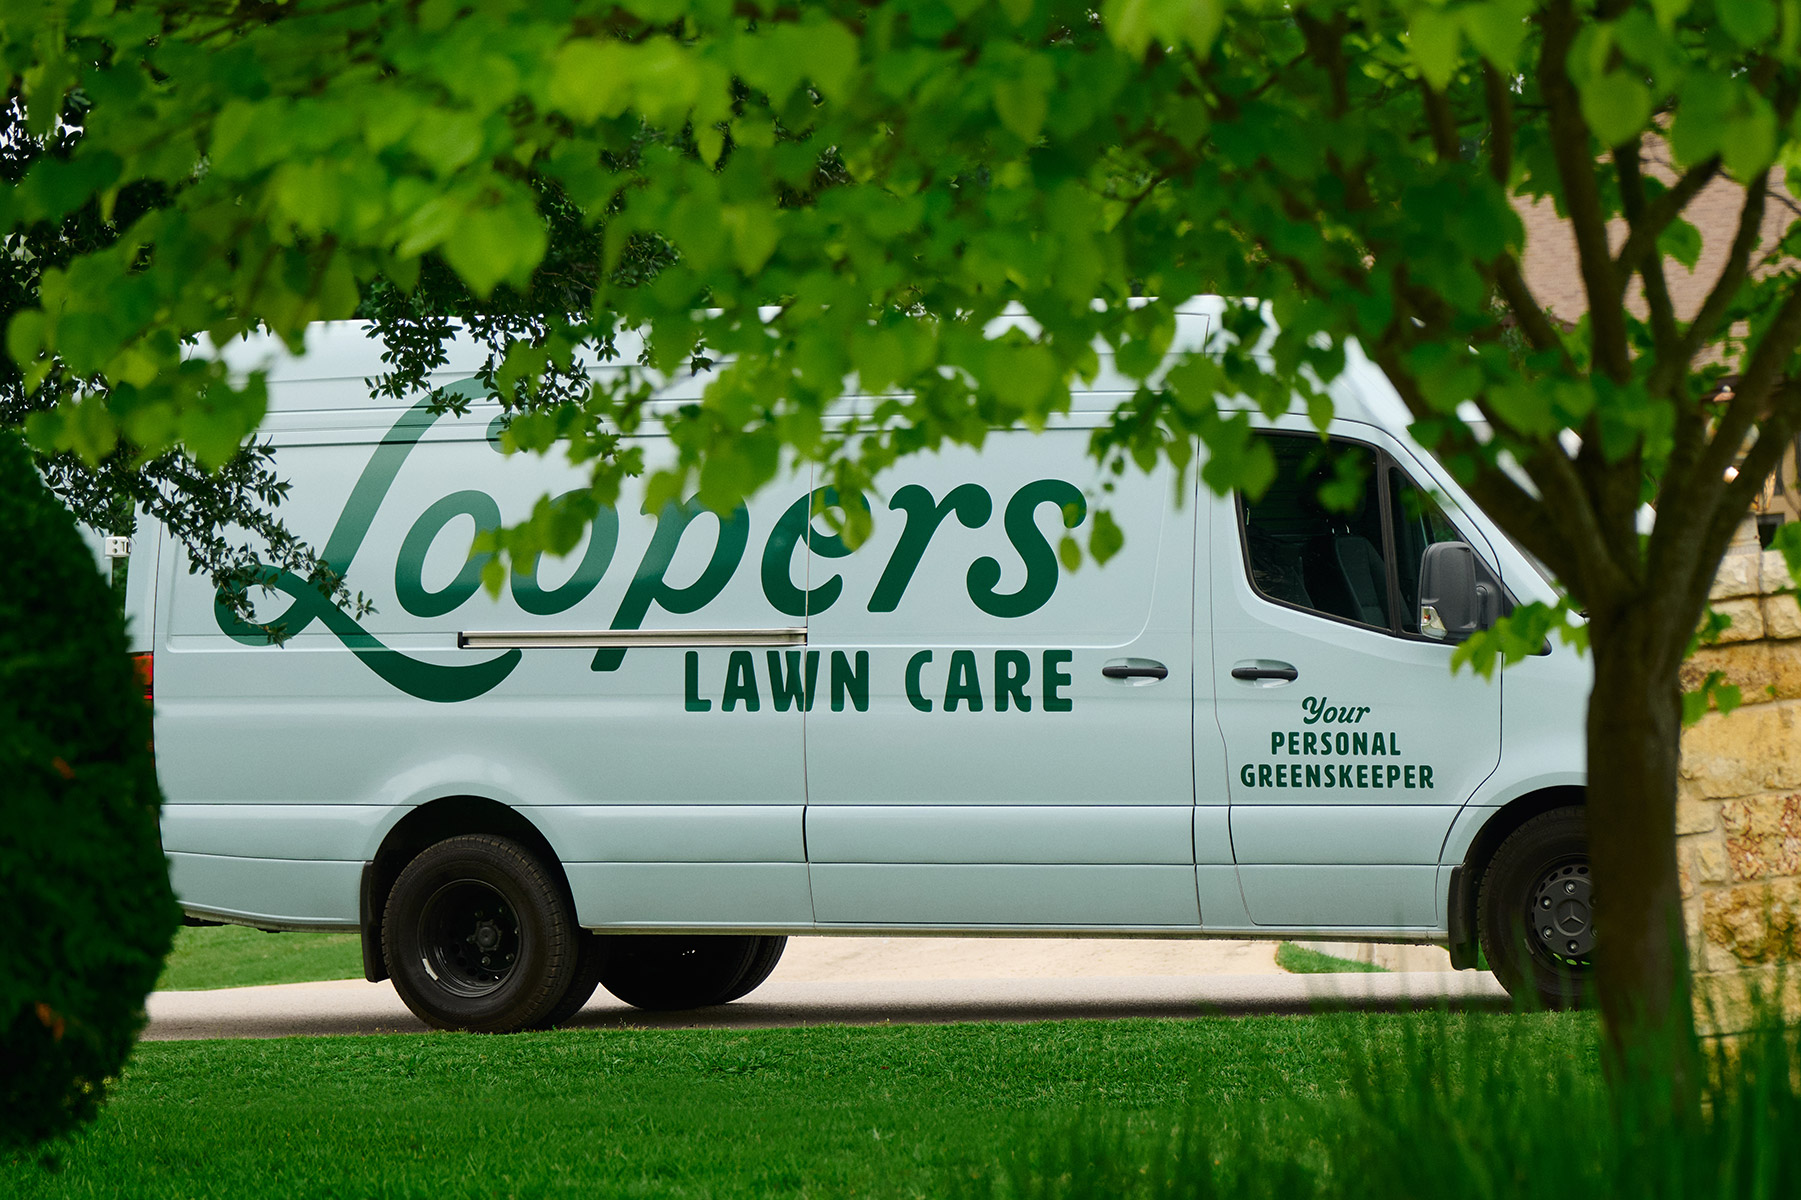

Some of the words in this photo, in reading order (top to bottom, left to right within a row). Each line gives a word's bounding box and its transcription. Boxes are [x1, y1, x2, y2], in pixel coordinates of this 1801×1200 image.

[684, 649, 870, 713] LAWN
[905, 649, 1073, 713] CARE
[1301, 696, 1371, 725] Your
[1271, 731, 1401, 756] PERSONAL
[1240, 763, 1434, 789] GREENSKEEPER
